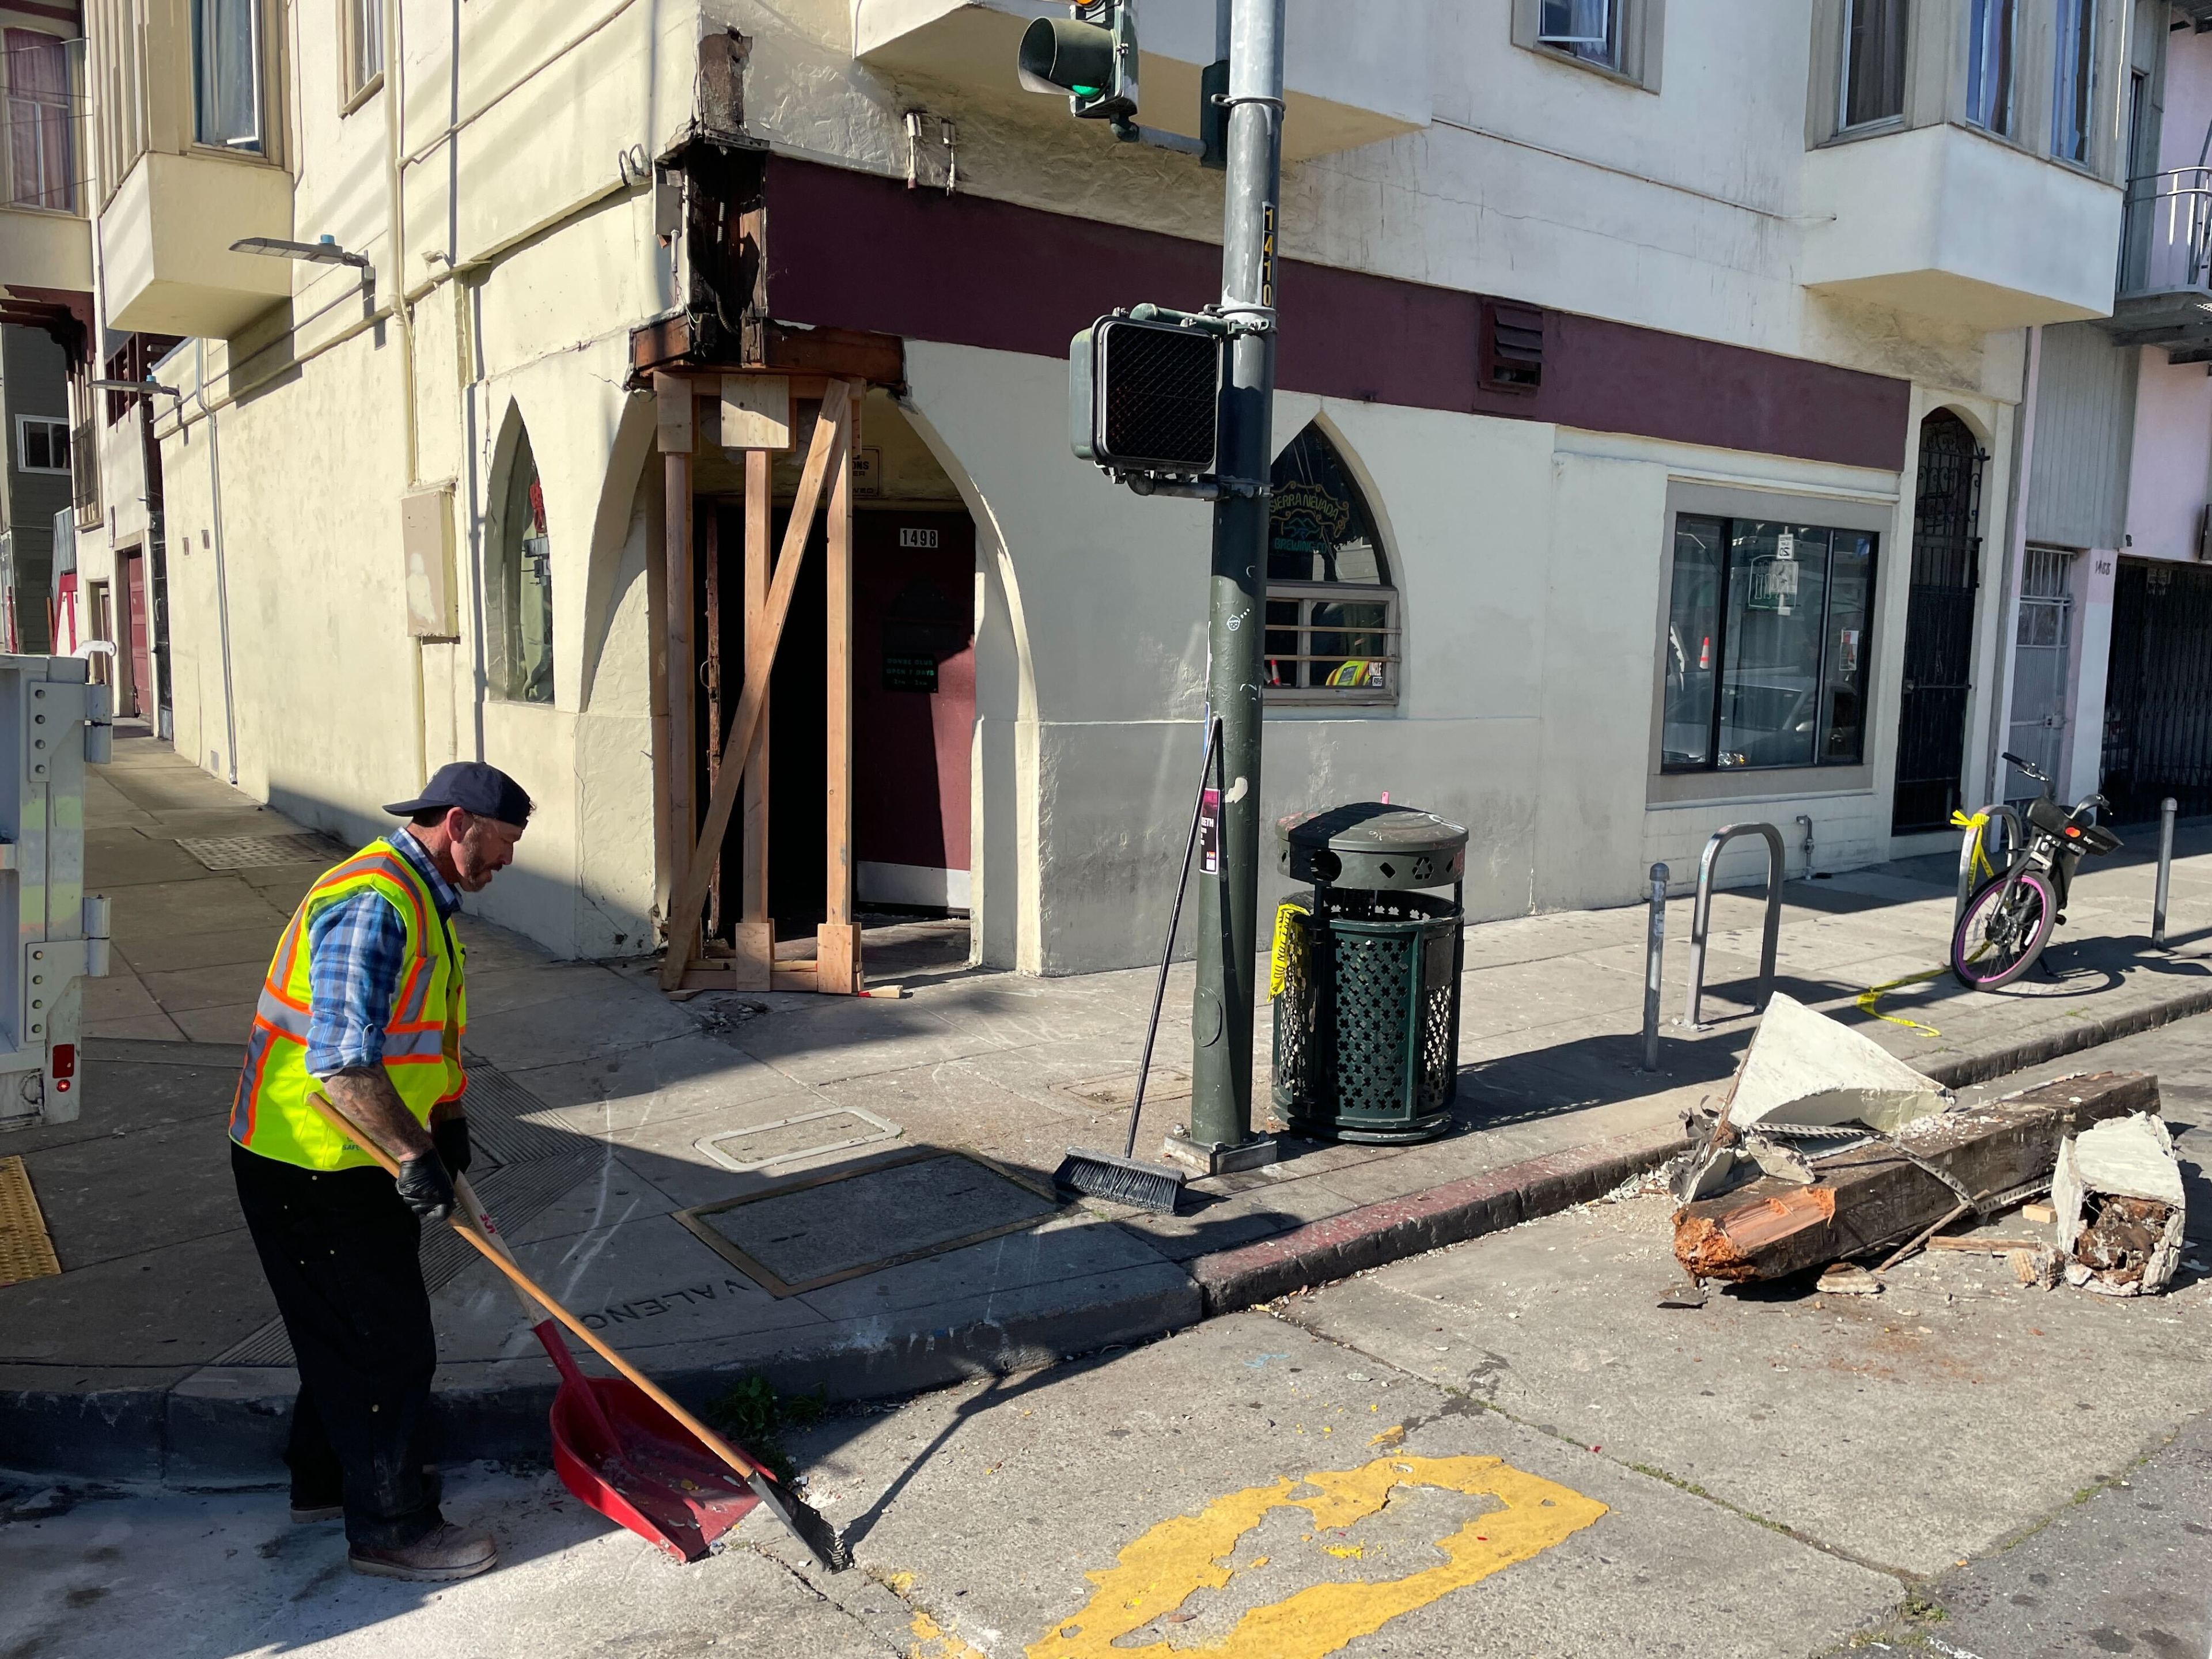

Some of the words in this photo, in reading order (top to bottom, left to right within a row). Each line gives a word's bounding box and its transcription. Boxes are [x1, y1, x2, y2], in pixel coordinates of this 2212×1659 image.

[1263, 209, 1273, 306] 1410
[1269, 493, 1302, 513] SIERRA
[903, 529, 937, 547] 1498
[581, 1279, 749, 1330] VALENC
